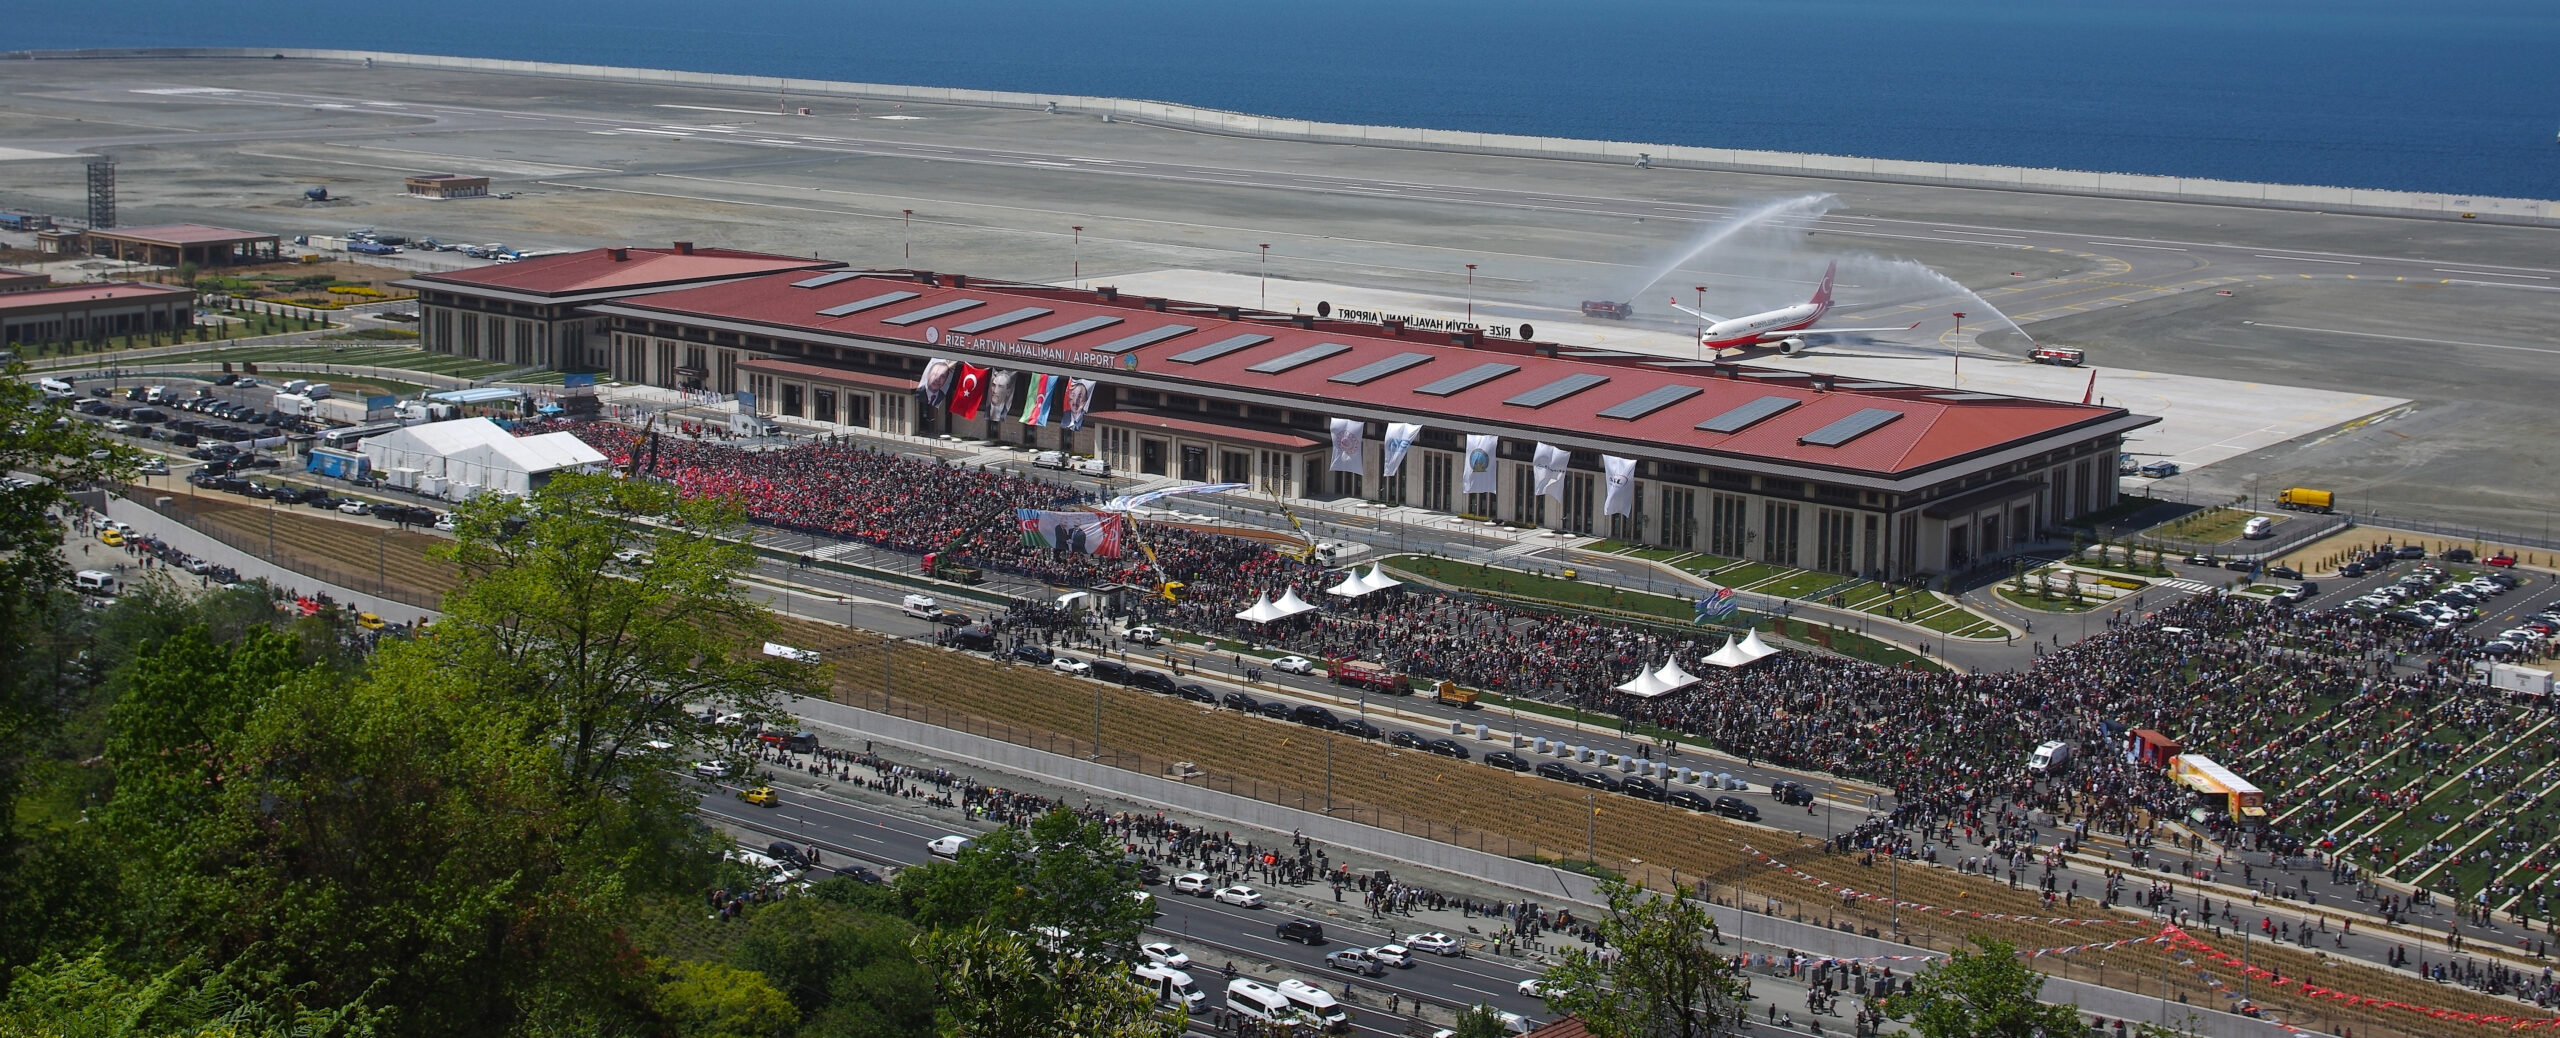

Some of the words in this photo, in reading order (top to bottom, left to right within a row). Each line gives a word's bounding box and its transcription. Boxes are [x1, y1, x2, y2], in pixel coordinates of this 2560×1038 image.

[945, 332, 965, 347] RİZE
[973, 338, 1006, 352] ARTVİN
[1009, 342, 1065, 361] HAVALİMANI
[1073, 351, 1115, 367] AIRPORT
